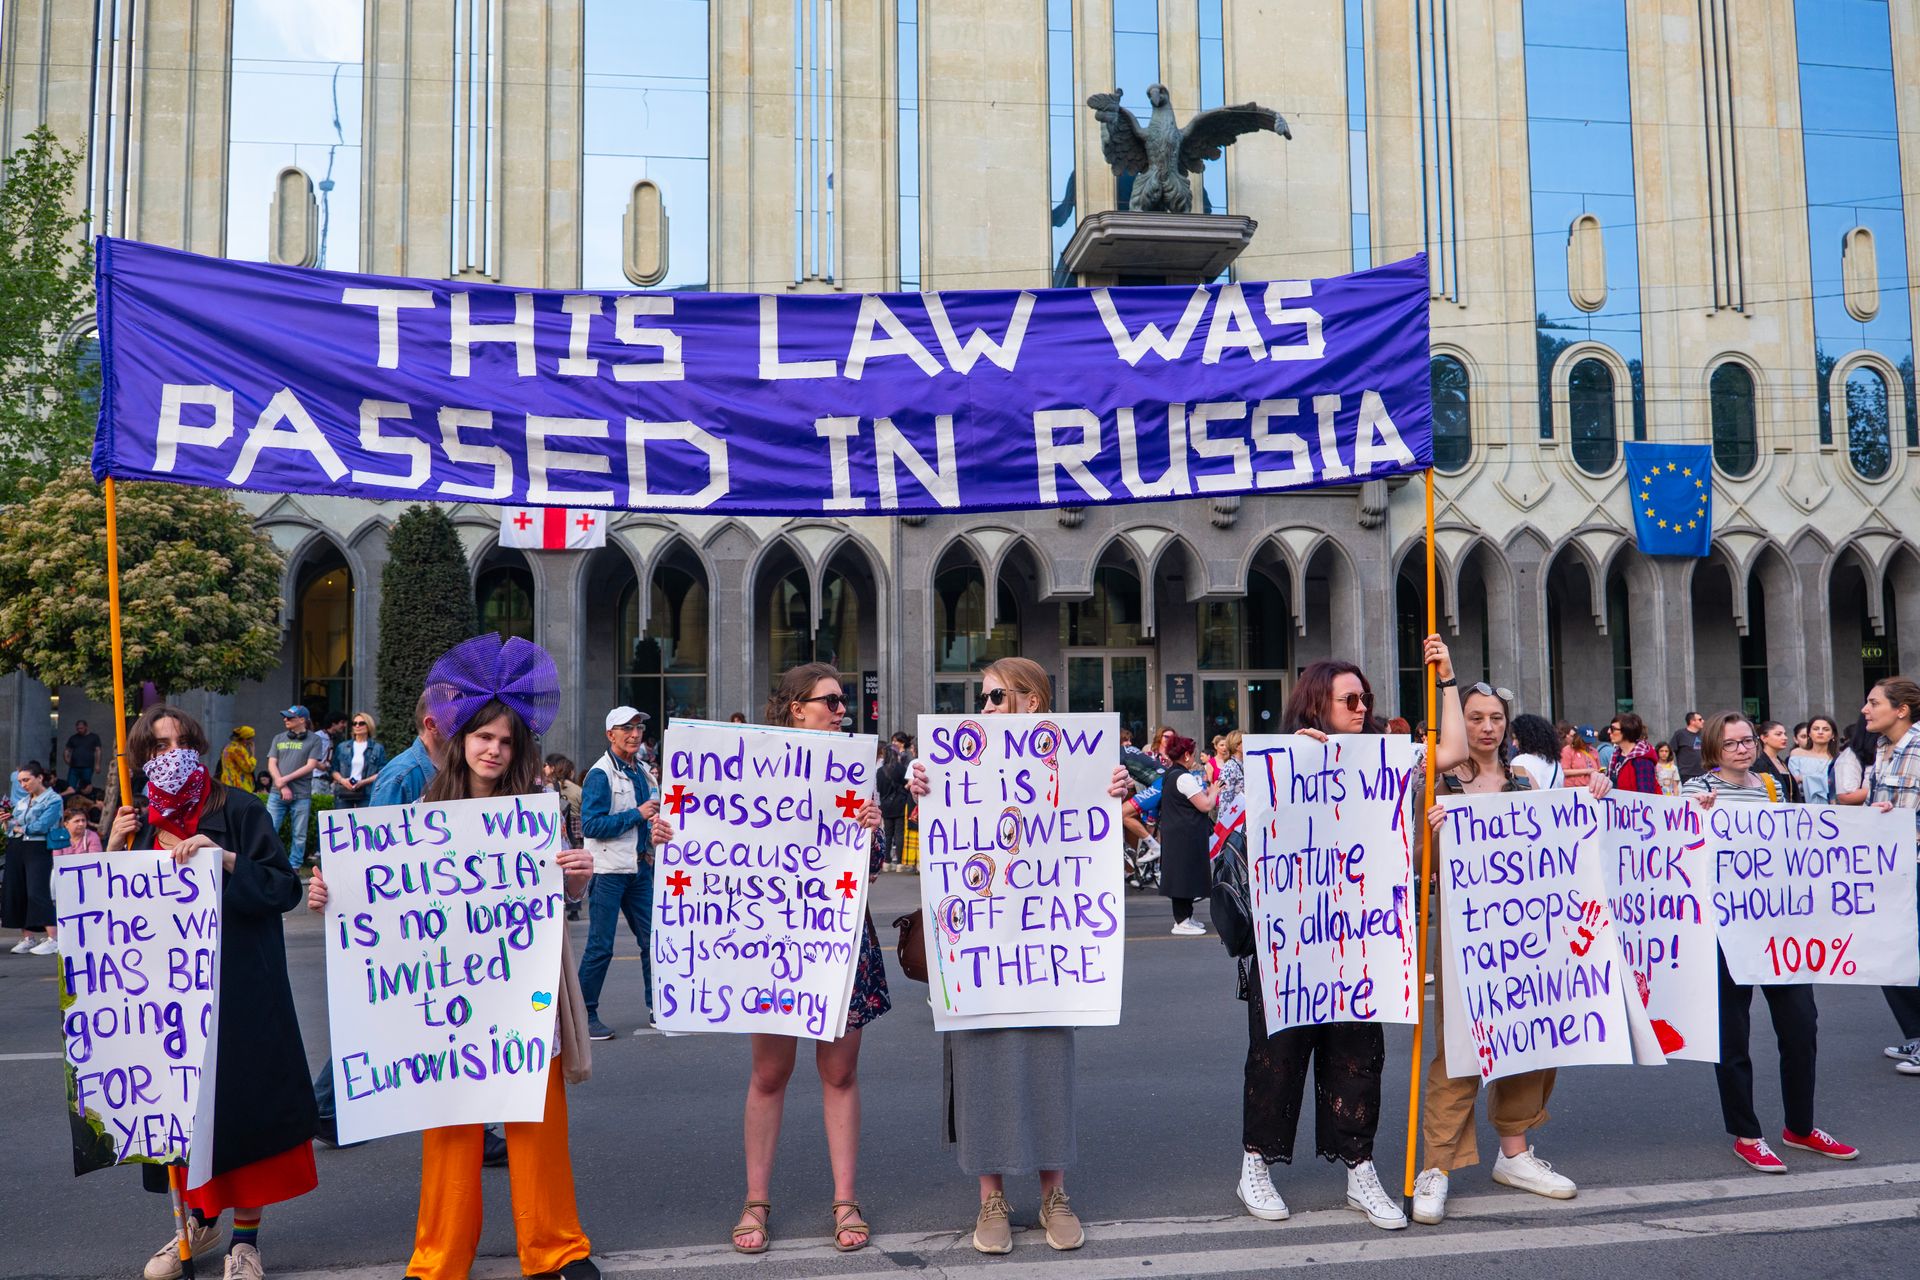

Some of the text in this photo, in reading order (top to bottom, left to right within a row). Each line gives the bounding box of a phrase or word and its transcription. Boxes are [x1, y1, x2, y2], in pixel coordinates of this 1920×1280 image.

[341, 280, 1326, 382] THIS LAW WAS
[152, 383, 1416, 511] PASSED IN RUSSIA
[670, 736, 867, 785] and will be
[930, 727, 1103, 765] SO NOW
[945, 769, 1037, 807] it is
[1246, 737, 1412, 831] That's why
[321, 797, 558, 853] that's why
[679, 788, 866, 851] passed here
[928, 806, 1110, 851] ALLOWED
[1443, 801, 1542, 845] That's
[1597, 798, 1656, 841] That's
[1711, 808, 1840, 841] QUOTAS
[662, 840, 830, 873] because
[930, 856, 1092, 894] TO CUT
[1256, 816, 1365, 895] torture
[1618, 845, 1692, 888] FUCK
[1716, 842, 1898, 884] FOR WOMEN
[59, 858, 200, 904] That's
[1831, 881, 1875, 916] BE
[58, 908, 218, 948] The WA
[338, 893, 563, 951] is no longer
[657, 886, 853, 932] thinks that
[946, 892, 1118, 938] OFF EARS
[1266, 885, 1407, 954] is allowed
[1462, 889, 1583, 944] troops
[64, 948, 149, 996] HAS
[365, 937, 511, 1005] invited
[960, 944, 1106, 988] THERE
[1462, 931, 1547, 975] rape
[1618, 930, 1679, 982] hip!
[1764, 933, 1857, 976] 100%
[414, 992, 472, 1027] to
[658, 977, 827, 1036] is its colony
[1279, 962, 1377, 1024] there
[64, 997, 188, 1063] going
[1486, 1011, 1606, 1060] women
[342, 1025, 545, 1101] Eurovision
[77, 1065, 162, 1117] FOR
[113, 1113, 196, 1162] YEA
